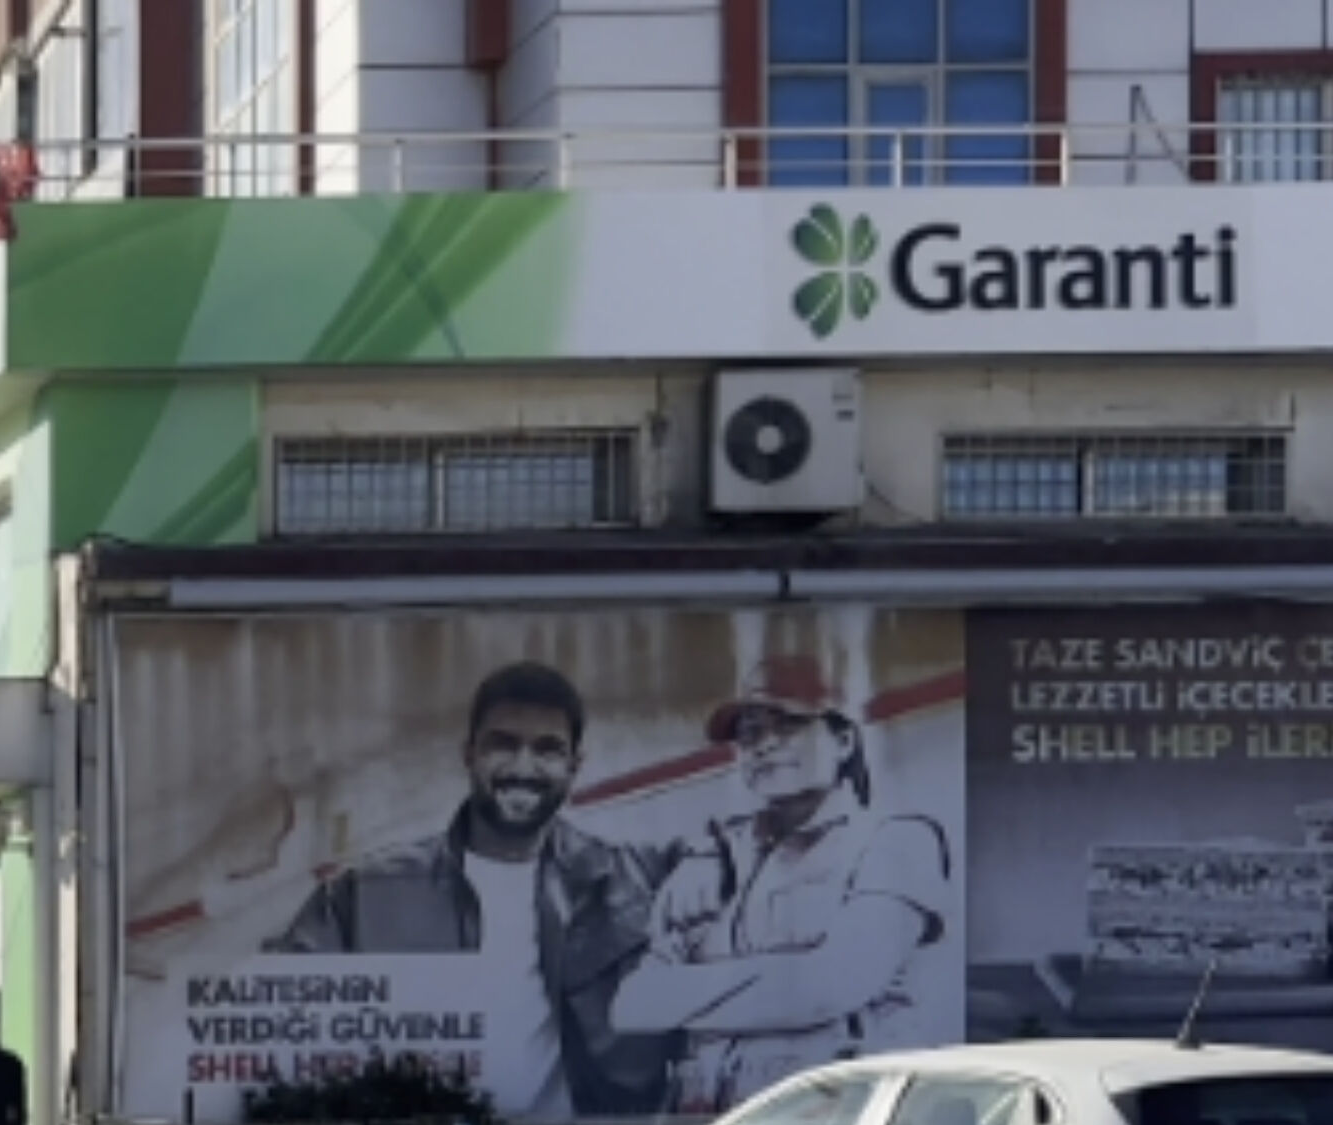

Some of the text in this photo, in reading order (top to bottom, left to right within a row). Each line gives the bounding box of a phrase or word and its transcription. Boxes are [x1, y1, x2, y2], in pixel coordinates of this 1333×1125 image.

[889, 222, 1237, 312] Garanti
[1011, 638, 1105, 669] TAZE
[1011, 724, 1136, 763] SHELL
[1150, 724, 1233, 760] HEP
[330, 1008, 485, 1041] GÜVENLE
